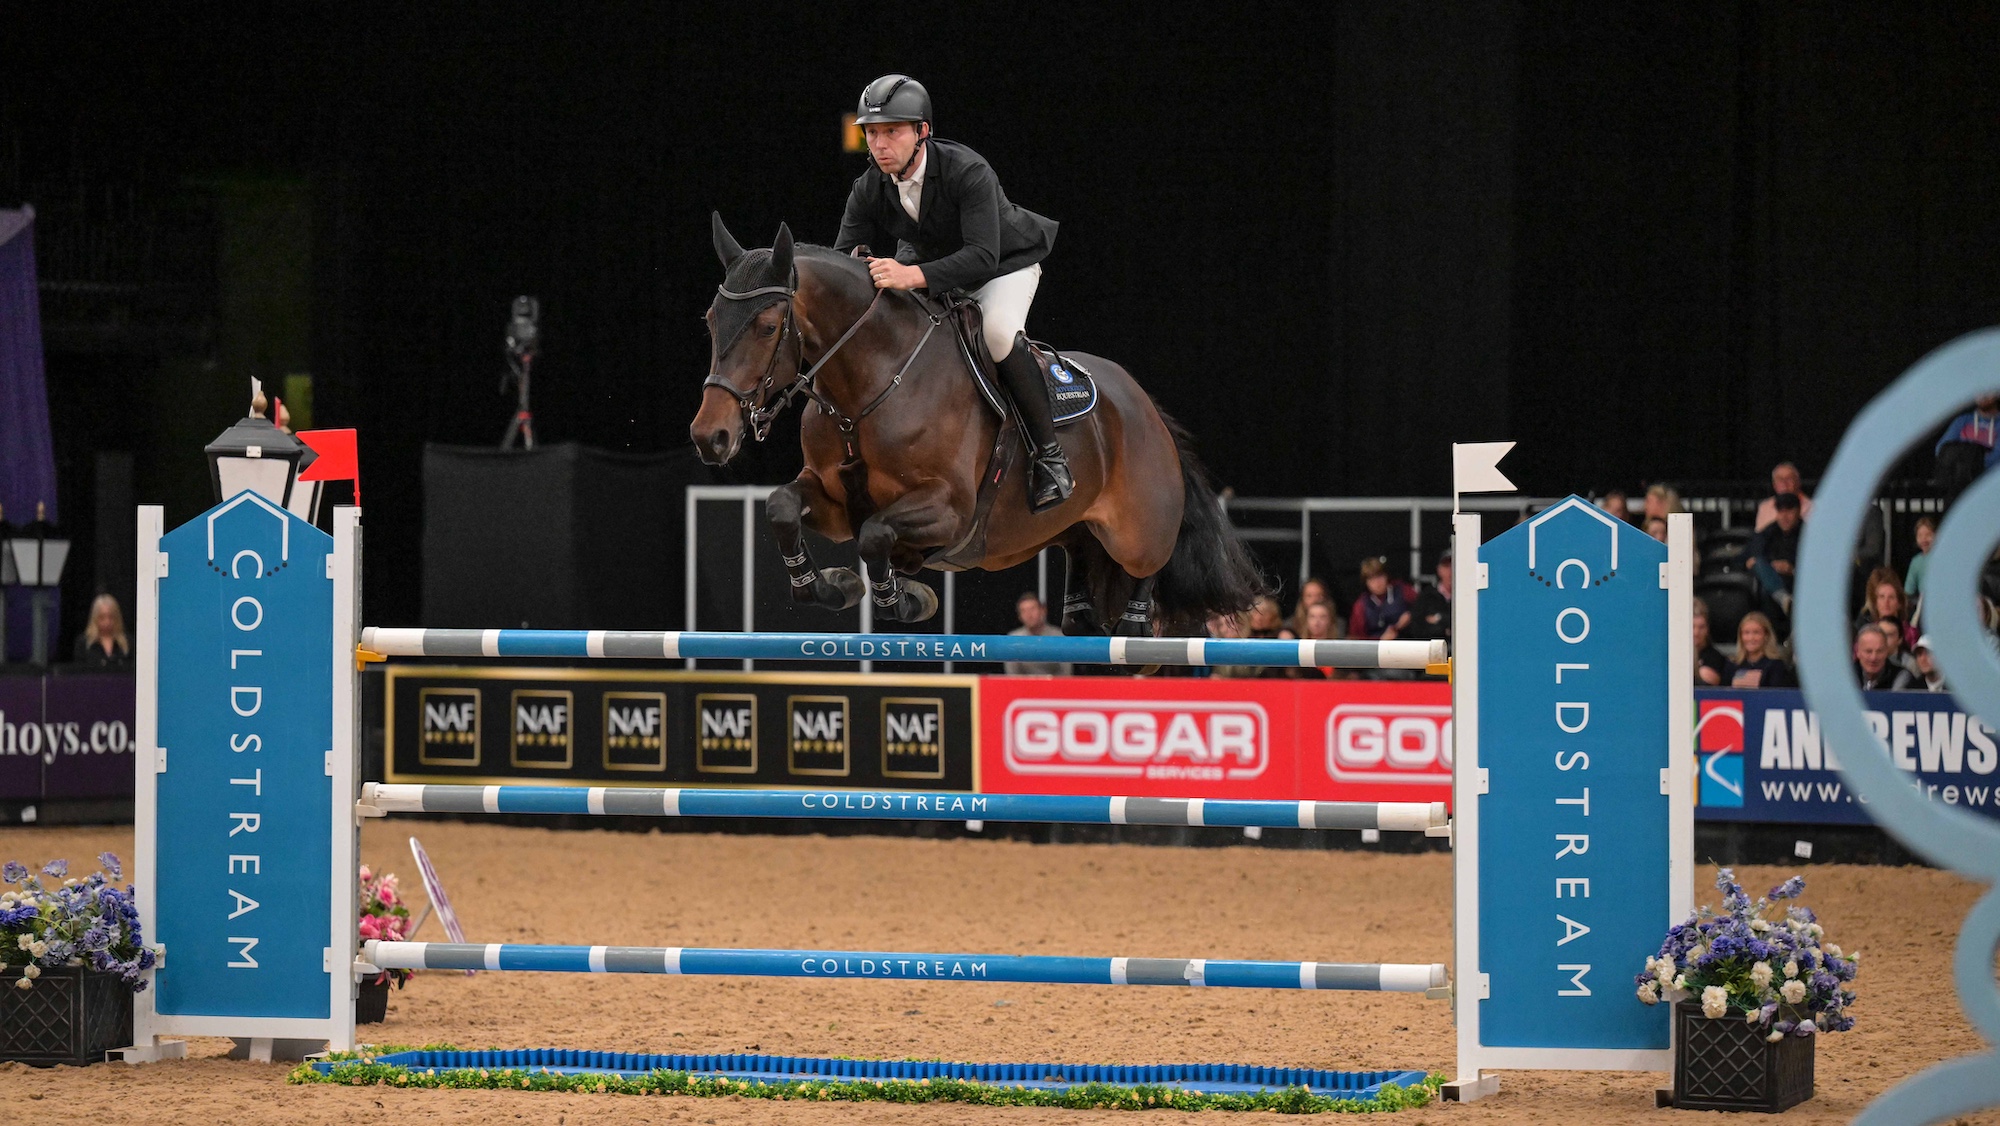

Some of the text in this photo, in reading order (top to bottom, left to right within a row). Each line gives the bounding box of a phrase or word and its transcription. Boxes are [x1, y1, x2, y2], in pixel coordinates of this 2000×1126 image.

[801, 640, 986, 657] COLDSTREAM
[424, 702, 475, 732] NAF
[516, 704, 567, 733] NAF
[608, 706, 660, 736] NAF
[702, 708, 751, 738] NAF
[793, 710, 844, 741] NAF
[886, 712, 938, 743] NAF
[1014, 710, 1256, 762] GOGAR
[1336, 716, 1452, 767] GO
[1760, 709, 1998, 775] ANREWS
[228, 549, 264, 969] COLDSTREAM
[1146, 765, 1224, 781] SERVICES
[1555, 558, 1592, 998] COLDSTREAM
[802, 793, 987, 812] COLDSTREAM
[802, 958, 986, 977] COLDSTREAM
